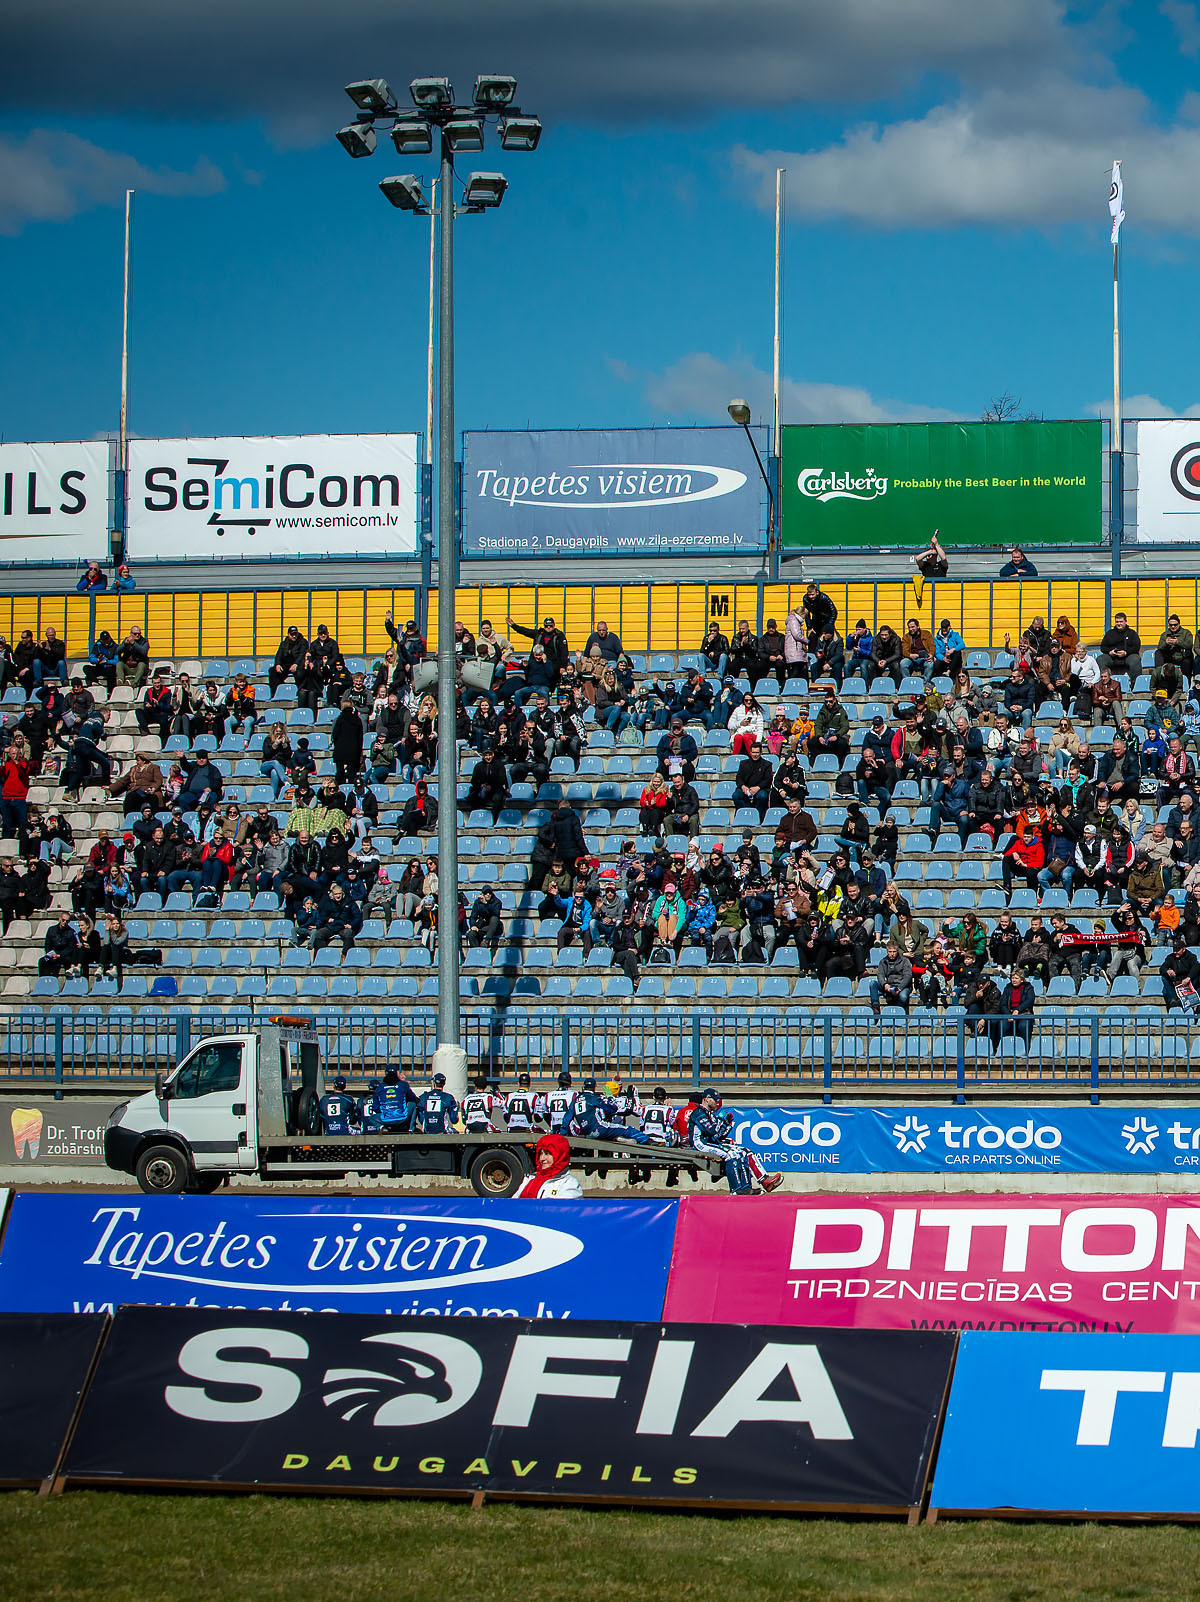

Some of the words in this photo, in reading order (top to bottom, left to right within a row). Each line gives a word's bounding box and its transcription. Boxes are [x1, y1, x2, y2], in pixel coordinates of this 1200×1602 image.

[145, 463, 399, 511] SemiCom
[477, 470, 590, 506] Tapetes
[598, 470, 692, 495] visiem
[798, 468, 888, 502] Carlsberg
[894, 478, 942, 489] Probably
[945, 478, 961, 487] the
[992, 478, 1016, 486] Beer
[1021, 477, 1029, 486] in
[1033, 477, 1050, 485] the
[1054, 476, 1085, 485] World
[4, 471, 86, 515] ILS
[276, 513, 398, 528] www.semicom.lv
[479, 536, 528, 548] Stadiona
[532, 536, 541, 548] 2,
[546, 535, 608, 550] Daugavpils
[617, 533, 743, 546] www.zila-ezerzeme.lv
[711, 595, 729, 616] M
[330, 1105, 337, 1115] 3
[431, 1101, 437, 1111] 7
[513, 1101, 524, 1112] 11
[553, 1100, 564, 1112] 12
[651, 1111, 658, 1121] 9
[48, 1126, 67, 1139] Dr.
[735, 1116, 842, 1146] rodo
[938, 1121, 1062, 1149] trodo
[754, 1153, 788, 1163] ARTS
[791, 1153, 840, 1164] ONLINE
[945, 1155, 969, 1164] CAR
[973, 1155, 1011, 1165] PARTS
[1015, 1155, 1061, 1165] ONLINE
[1174, 1156, 1199, 1165] CAR
[83, 1208, 276, 1280] Tapetes
[308, 1222, 488, 1271] visiem
[787, 1279, 1072, 1302] TIRDZNIECĪBAS
[282, 1454, 697, 1484] DAUGAVPILS
